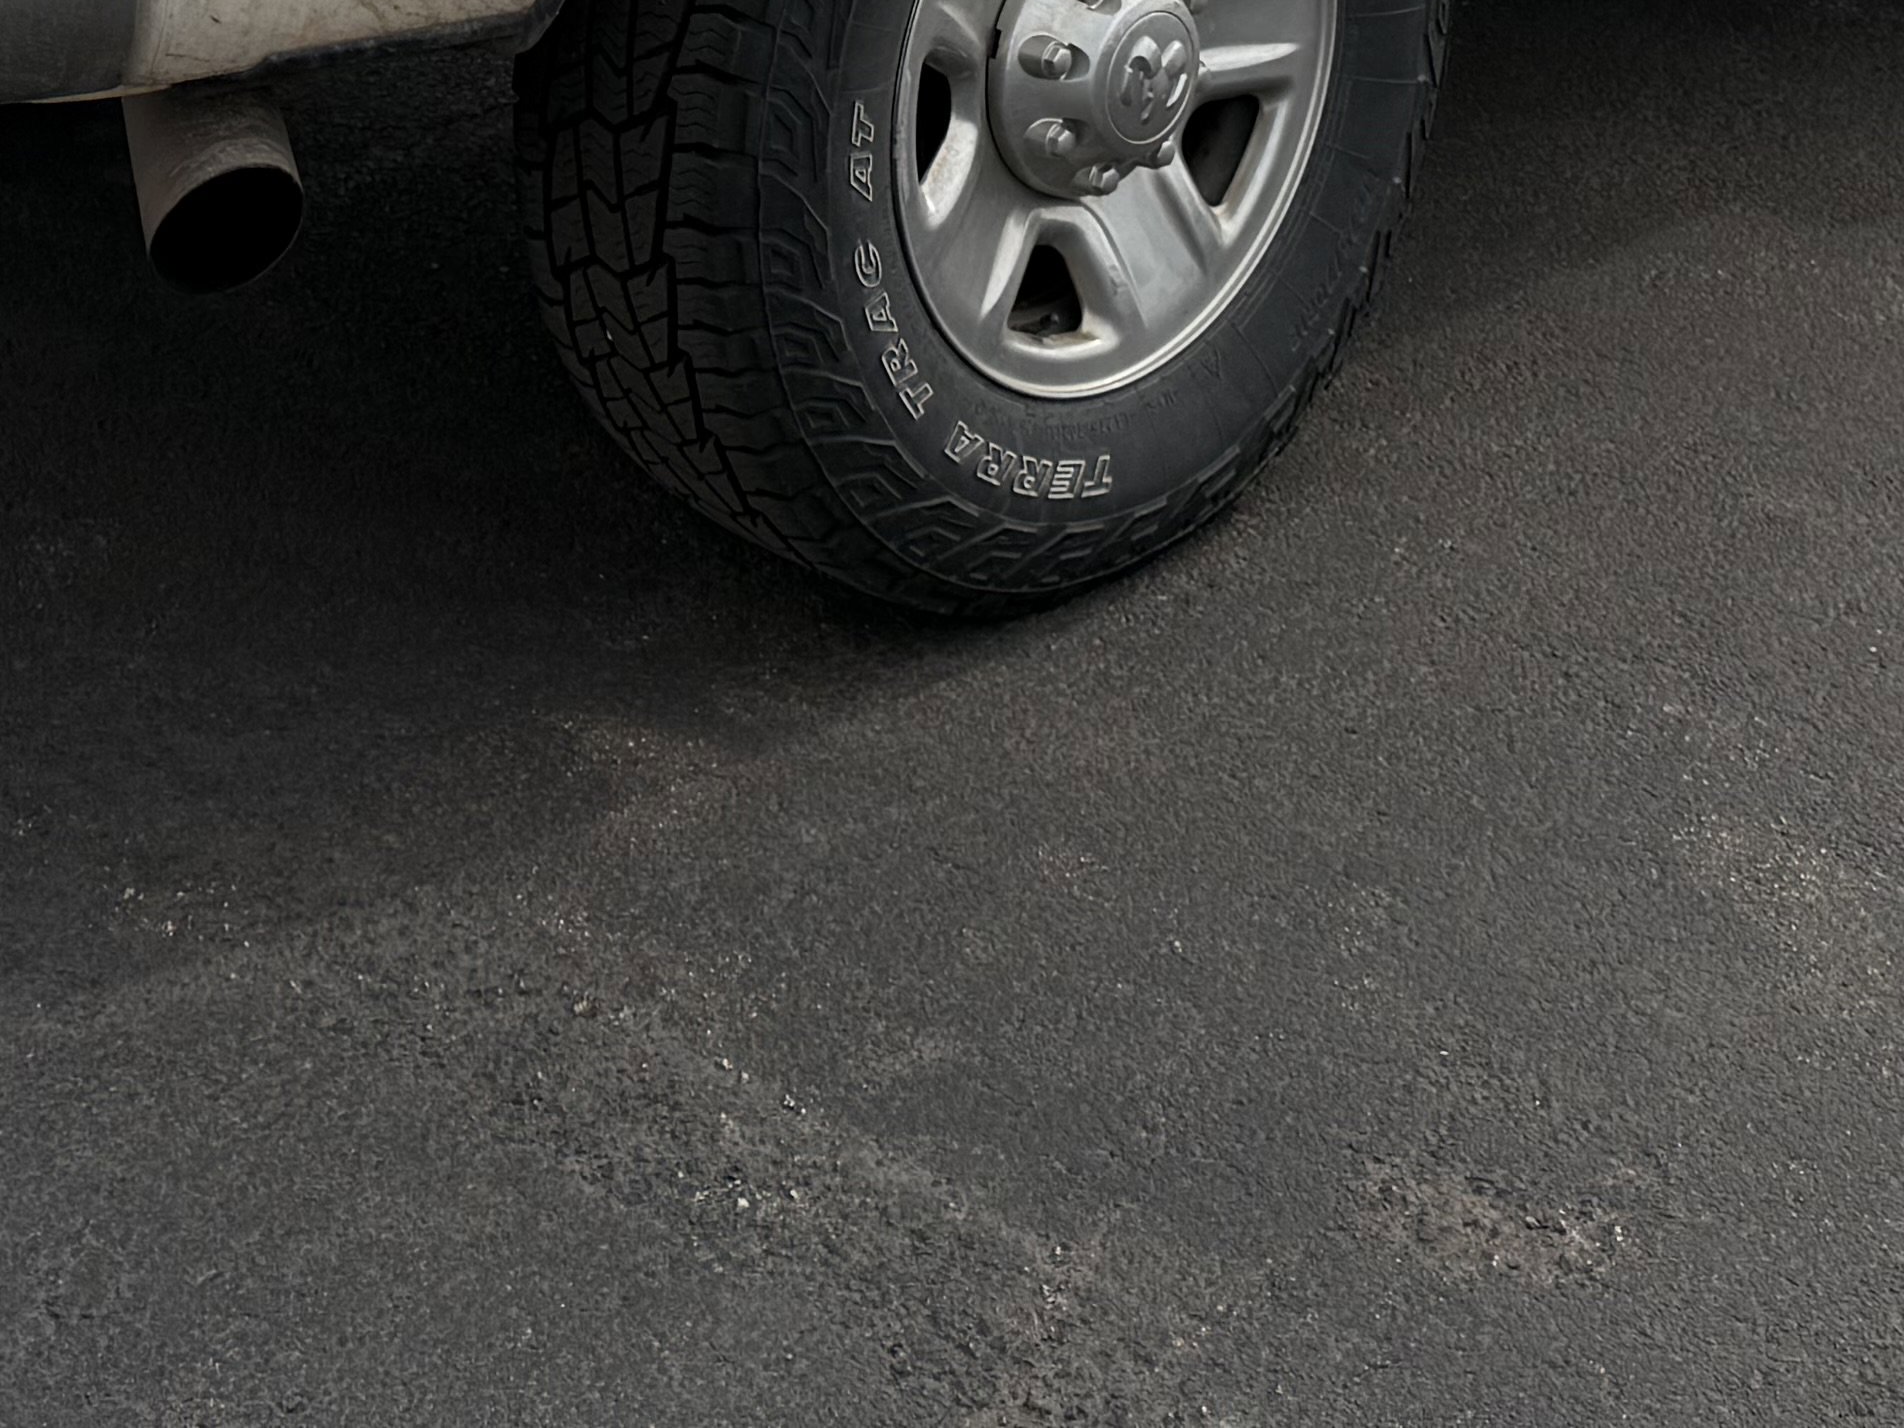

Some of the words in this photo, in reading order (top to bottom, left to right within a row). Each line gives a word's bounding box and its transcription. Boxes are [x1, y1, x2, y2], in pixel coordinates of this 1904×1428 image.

[850, 100, 875, 202] AT
[854, 239, 934, 421] TRAC
[944, 419, 1113, 499] TERRA
